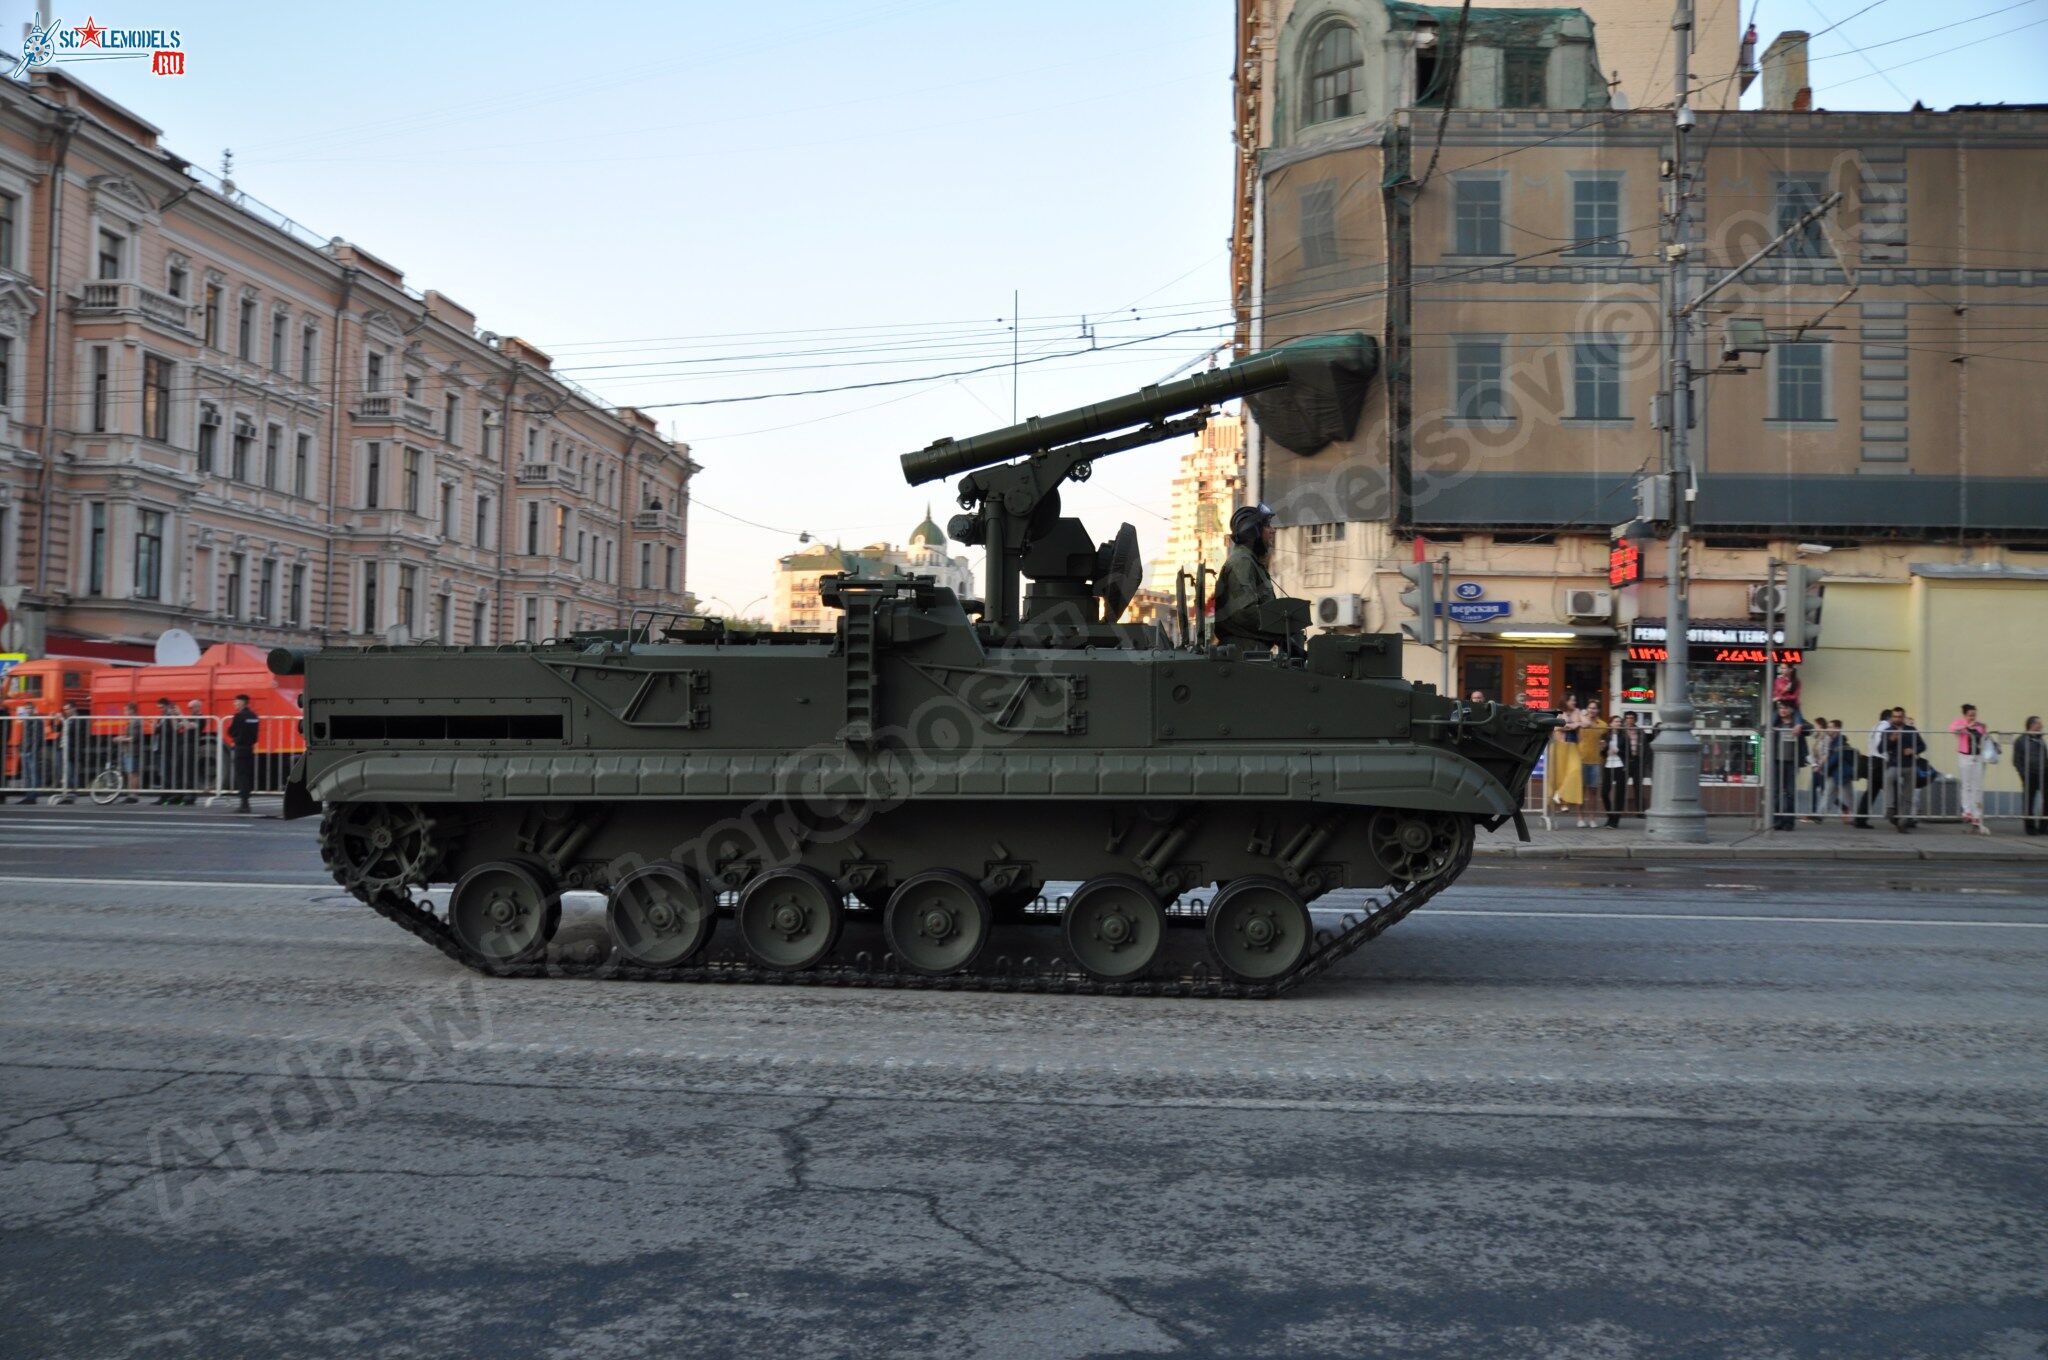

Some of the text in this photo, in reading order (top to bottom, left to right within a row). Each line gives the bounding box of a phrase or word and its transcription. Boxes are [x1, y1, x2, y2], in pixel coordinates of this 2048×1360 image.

[1461, 585, 1477, 596] 30
[1448, 603, 1500, 616] верская
[1633, 627, 1667, 641] РЕМО
[1686, 629, 1737, 643] ОТОВЫХ
